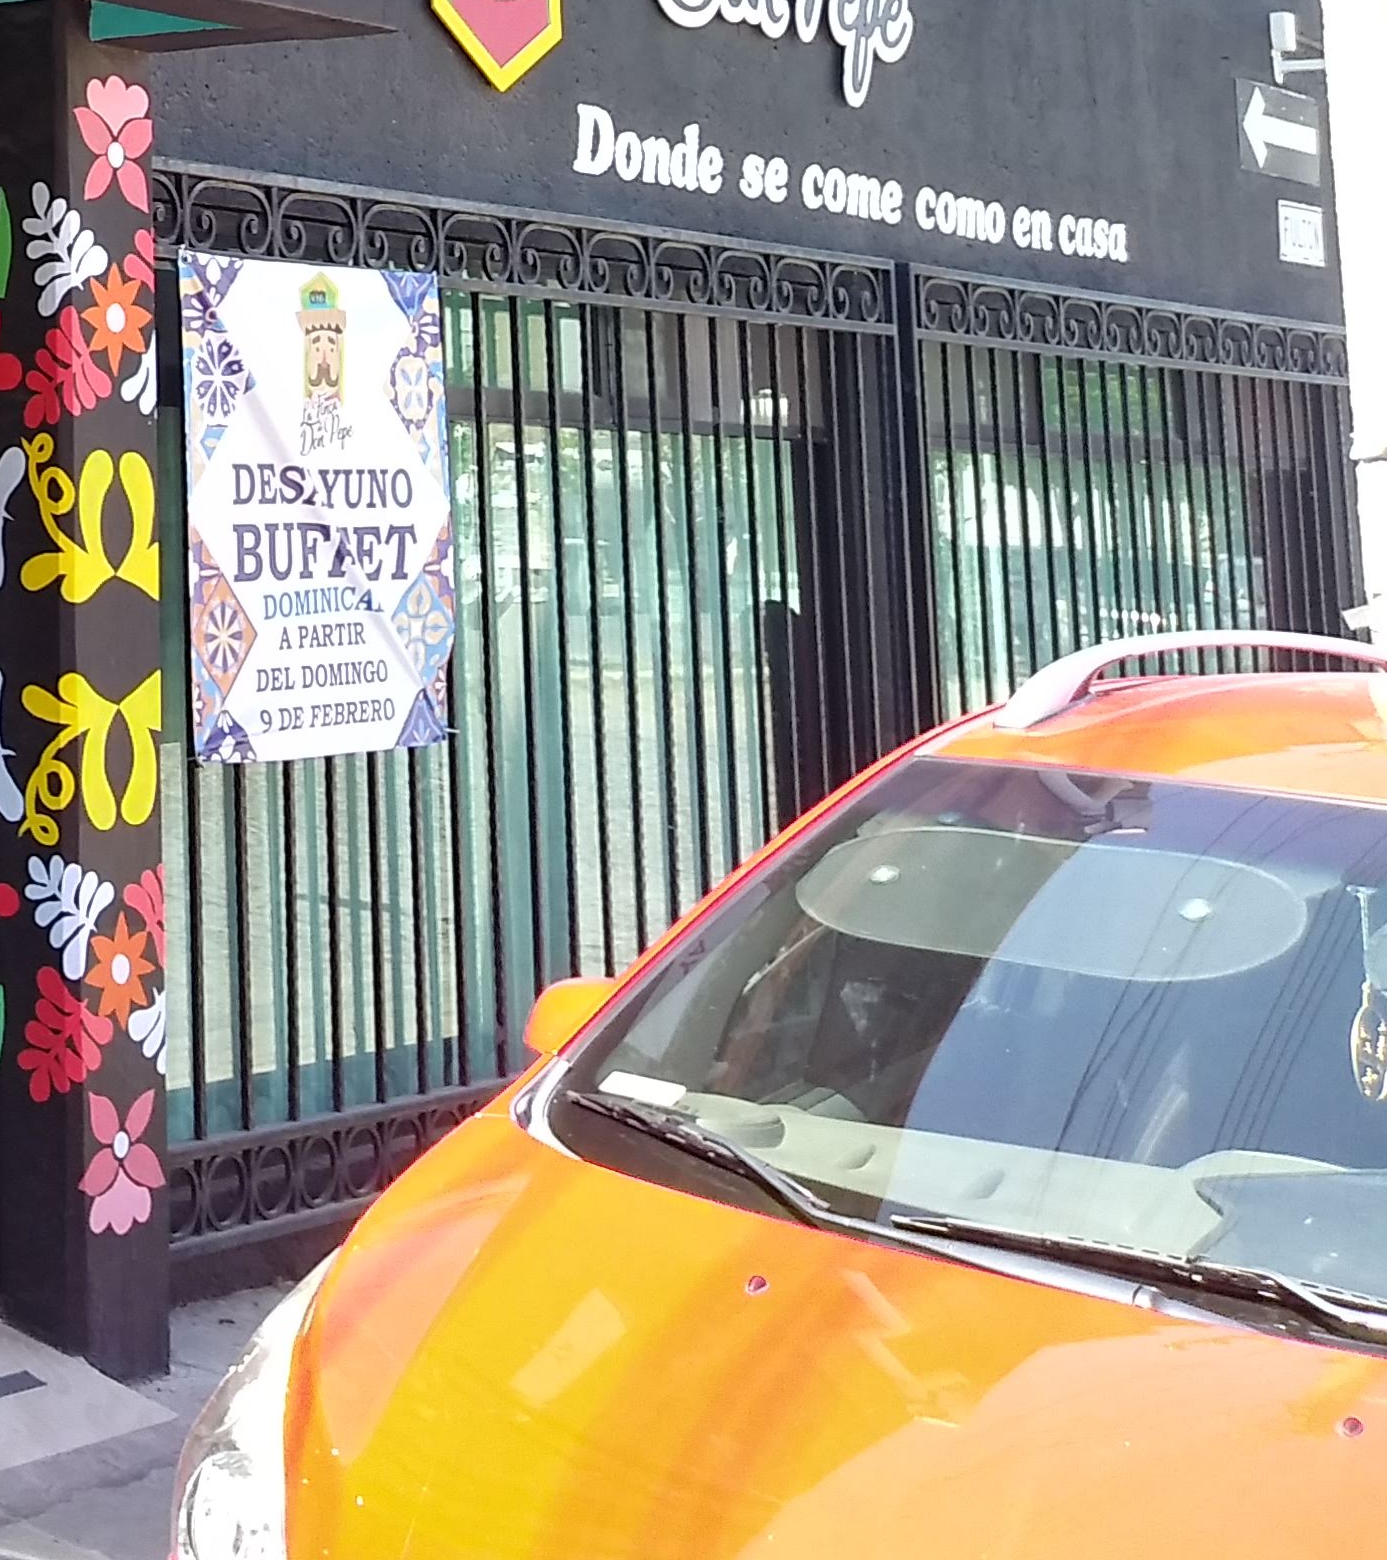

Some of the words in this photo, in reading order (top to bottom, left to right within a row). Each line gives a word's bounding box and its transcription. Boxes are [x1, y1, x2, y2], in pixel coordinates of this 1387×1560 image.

[573, 103, 724, 195] Donde
[739, 153, 789, 203] se
[801, 162, 903, 225] come
[915, 184, 1005, 243] como
[1012, 205, 1053, 252] en
[1058, 213, 1128, 263] casa
[263, 586, 384, 620] DOMINICA
[278, 626, 293, 650] A
[298, 622, 366, 649] PARTIR
[256, 667, 296, 692] DEL
[301, 659, 388, 689] DOMINGO
[260, 709, 273, 734] 9
[278, 706, 305, 731] DE
[309, 698, 395, 728] FEBRERO
